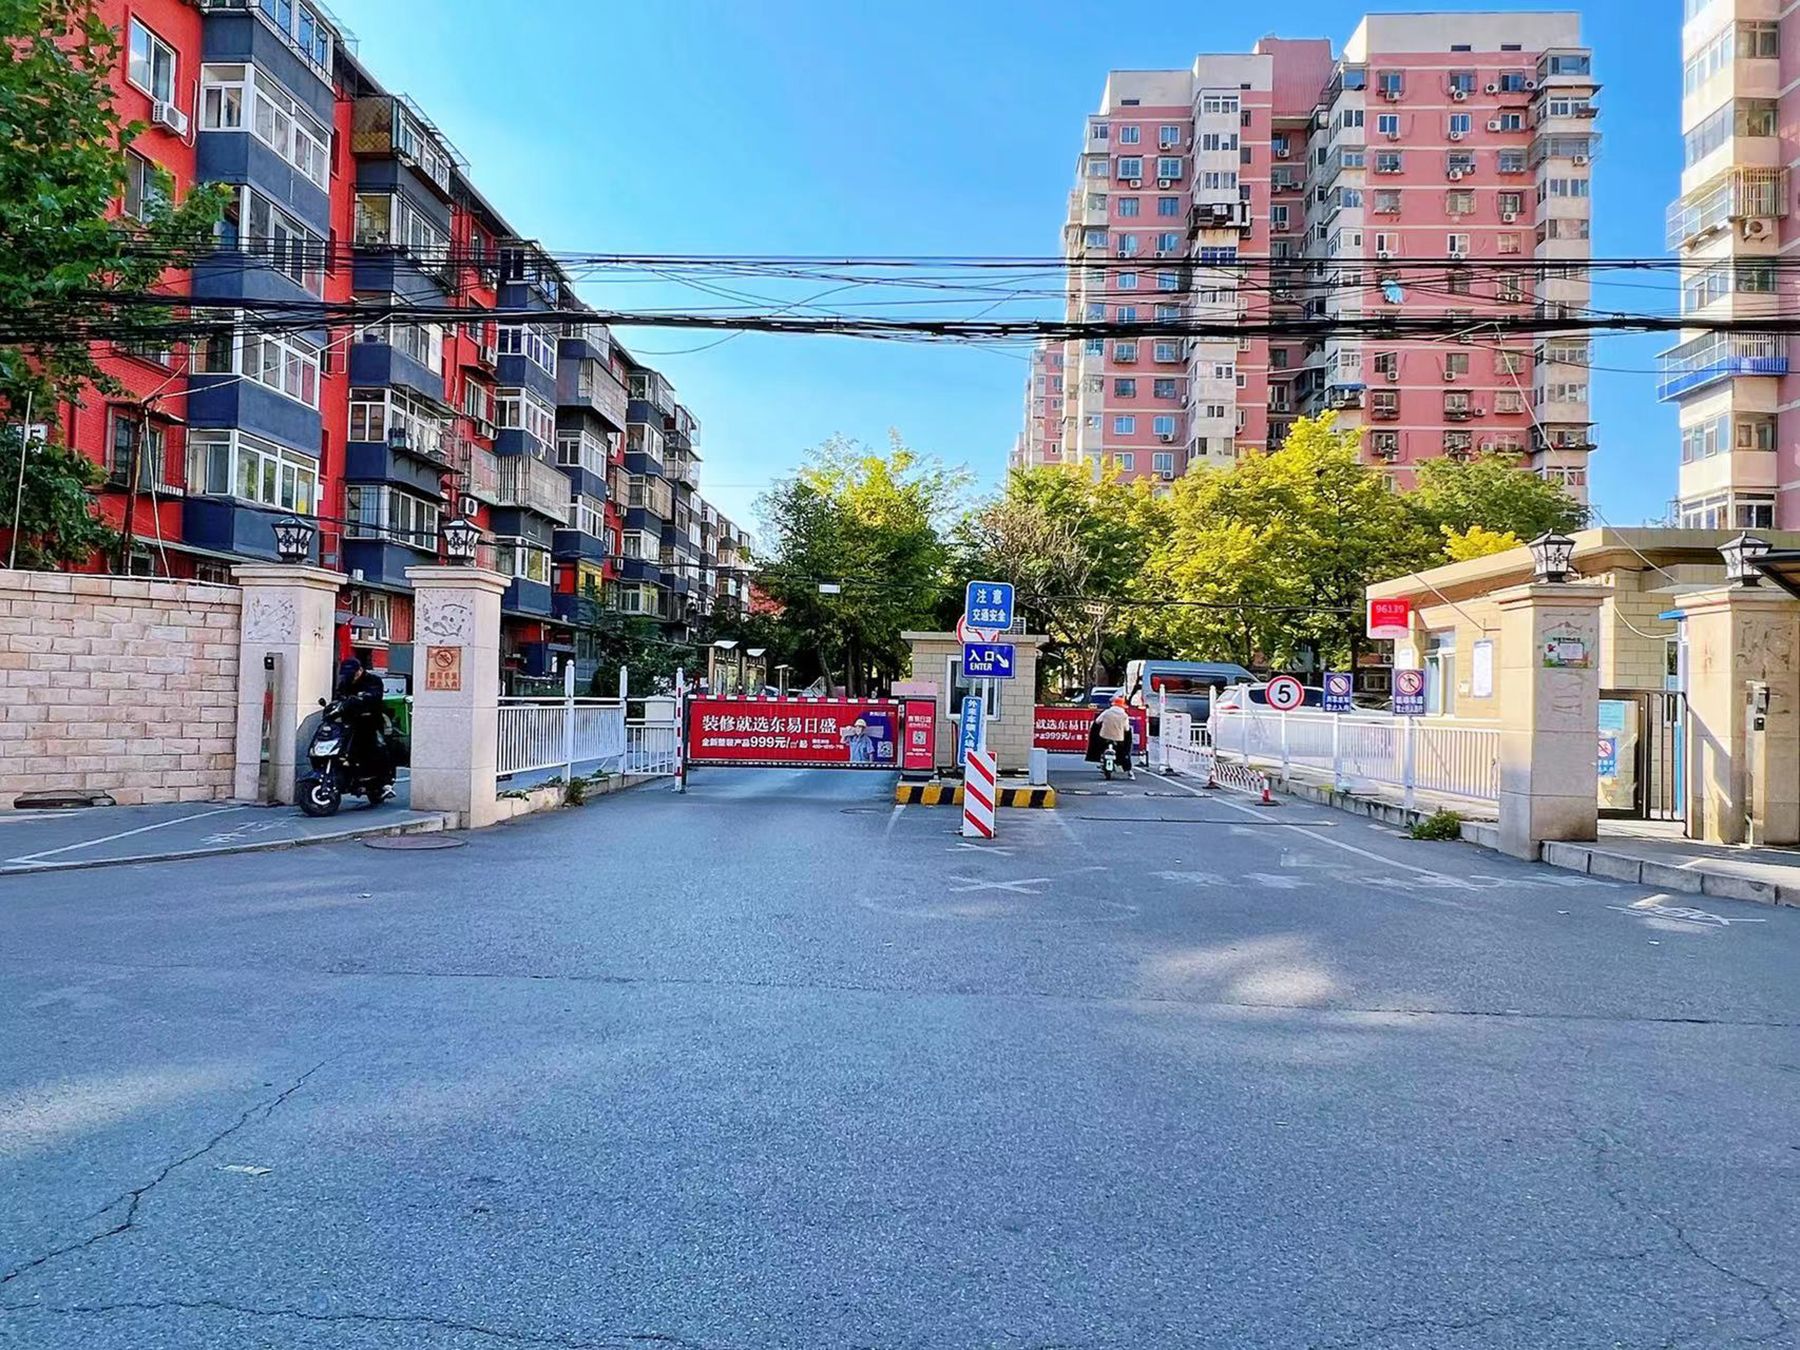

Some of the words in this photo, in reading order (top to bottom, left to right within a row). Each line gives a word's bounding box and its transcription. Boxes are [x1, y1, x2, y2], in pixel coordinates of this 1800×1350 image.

[976, 589, 1003, 605] 注意
[972, 608, 1006, 622] 交通安全
[968, 649, 995, 662] 入口
[970, 661, 993, 671] ENTER
[1278, 684, 1291, 703] 5
[702, 715, 836, 734] 装修就选东易日盛
